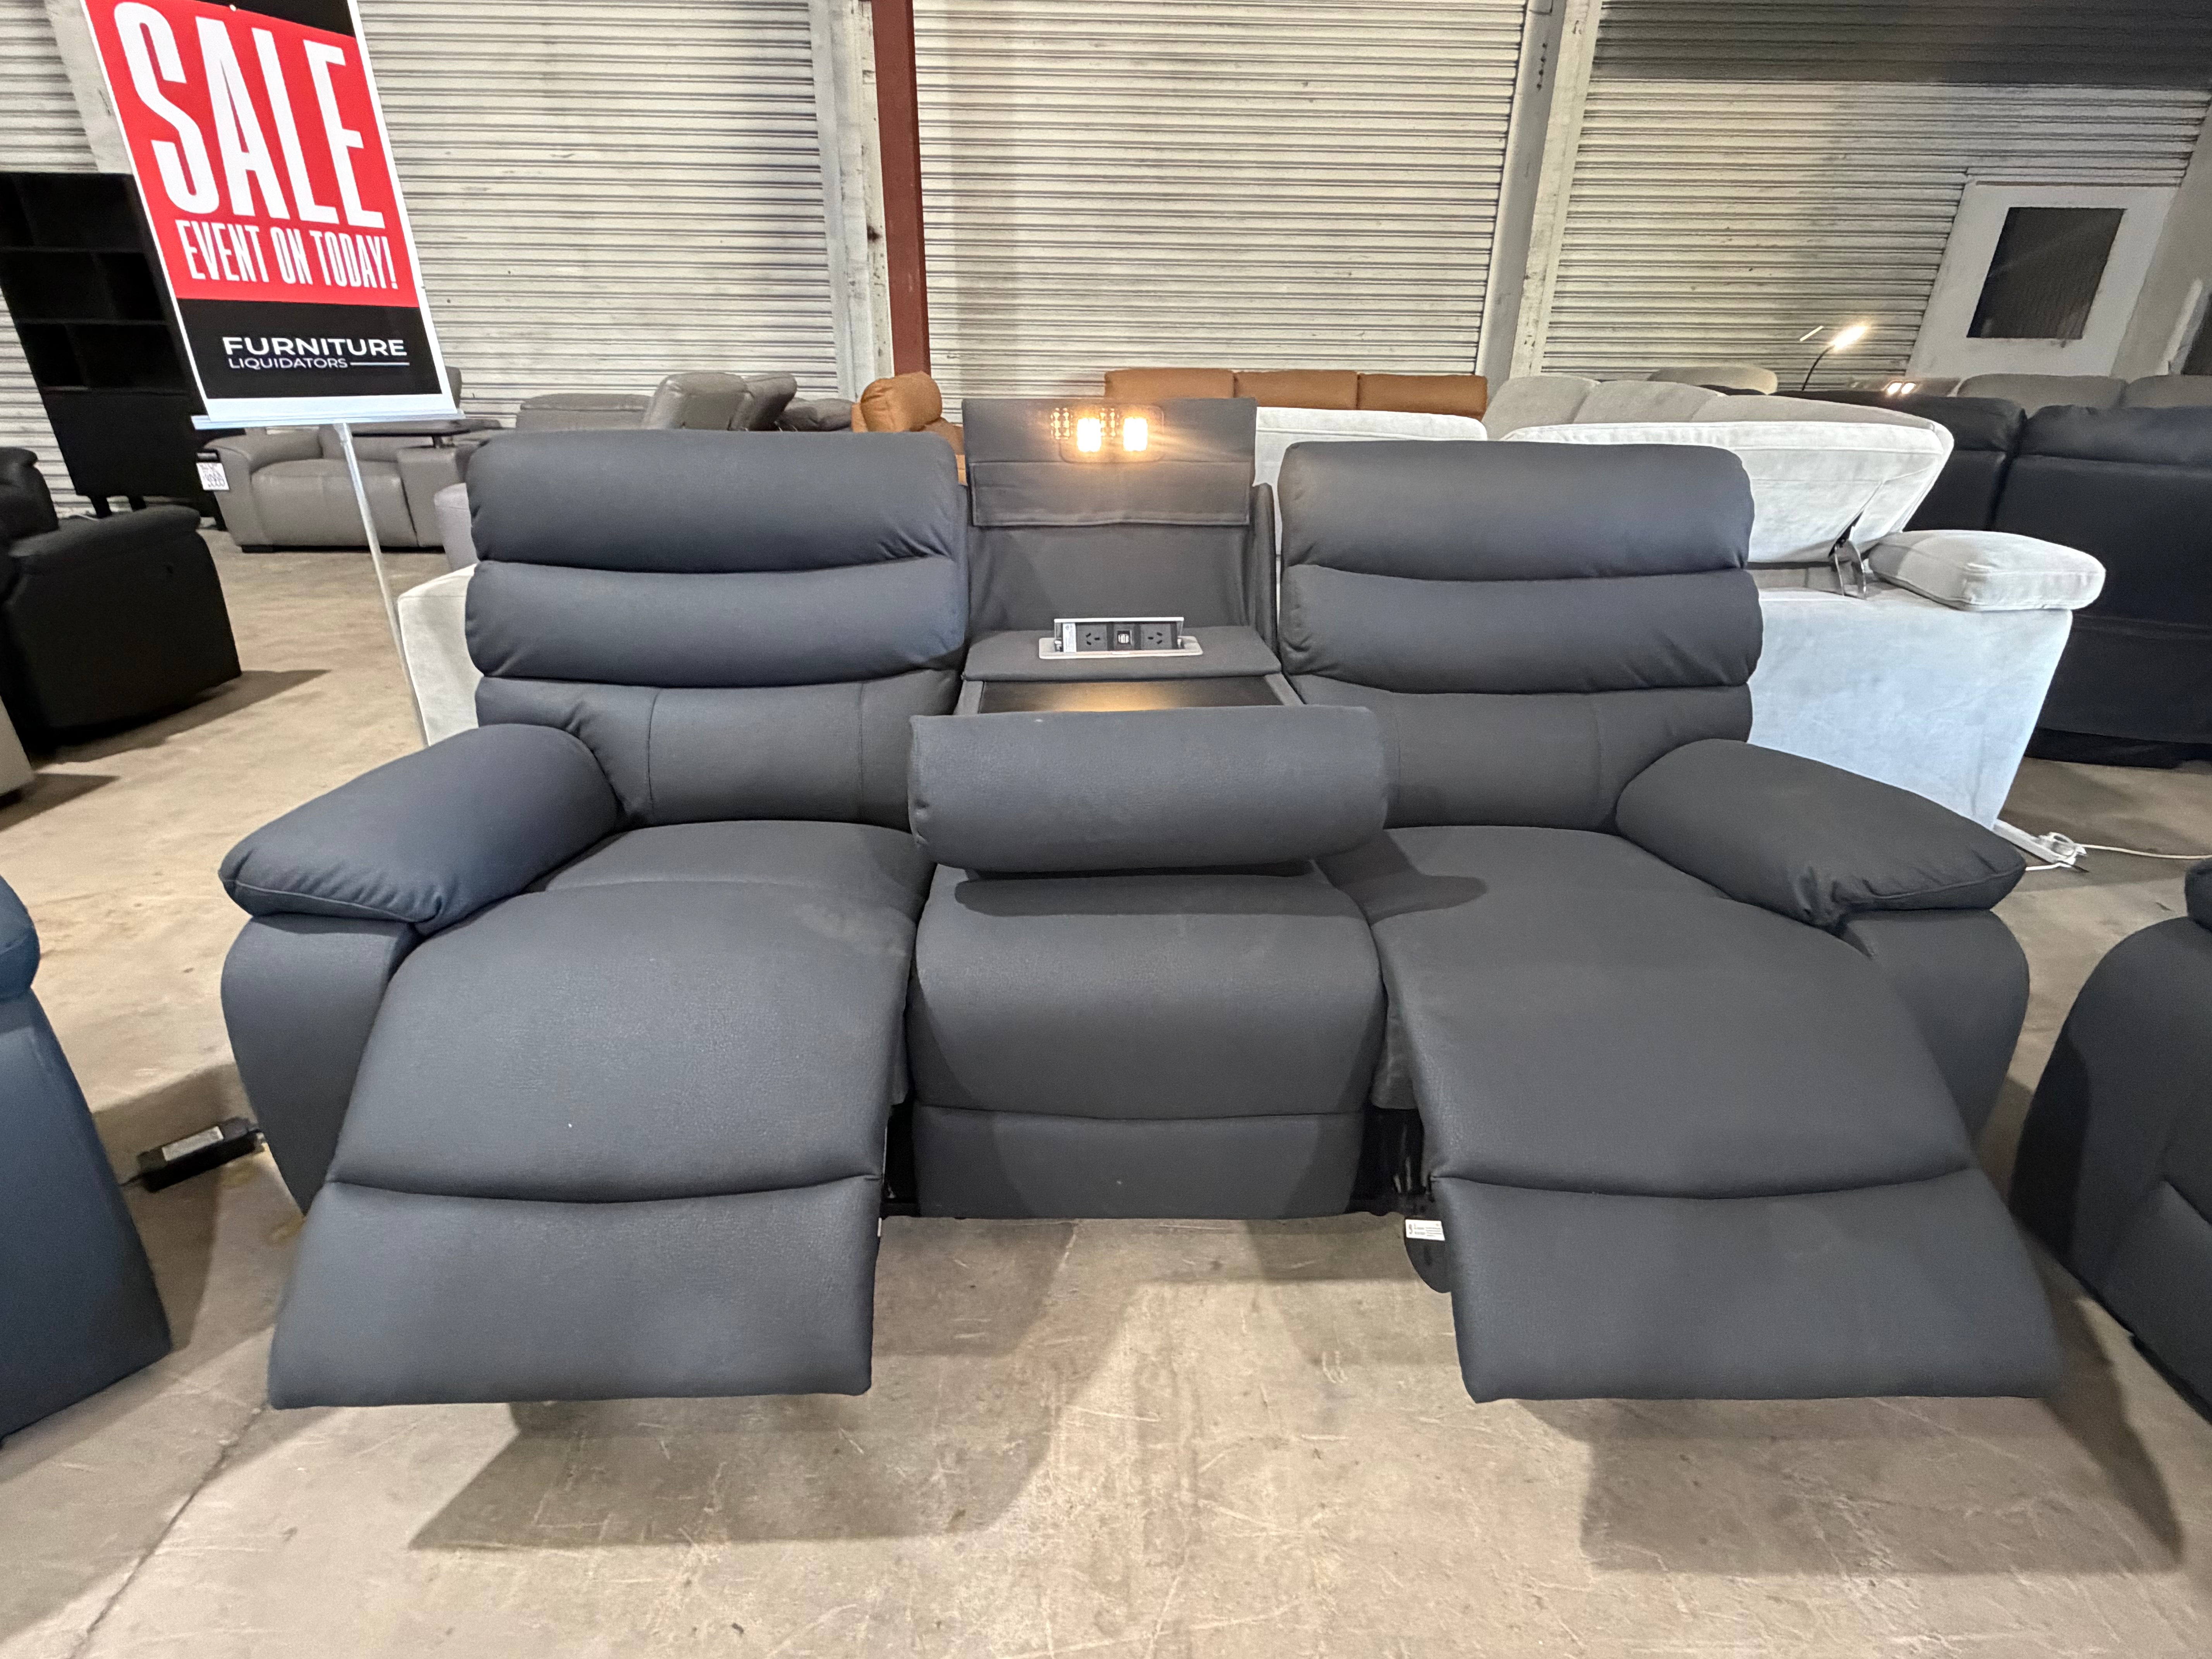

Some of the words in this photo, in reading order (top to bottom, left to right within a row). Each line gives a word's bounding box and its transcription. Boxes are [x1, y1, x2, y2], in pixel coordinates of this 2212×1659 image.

[113, 2, 386, 229] SALE
[175, 219, 270, 283] EVENT
[270, 226, 313, 285] ON
[309, 230, 398, 290] TODAY!
[222, 337, 407, 356] FURNITURE
[228, 357, 348, 370] LIQUIDATORS
